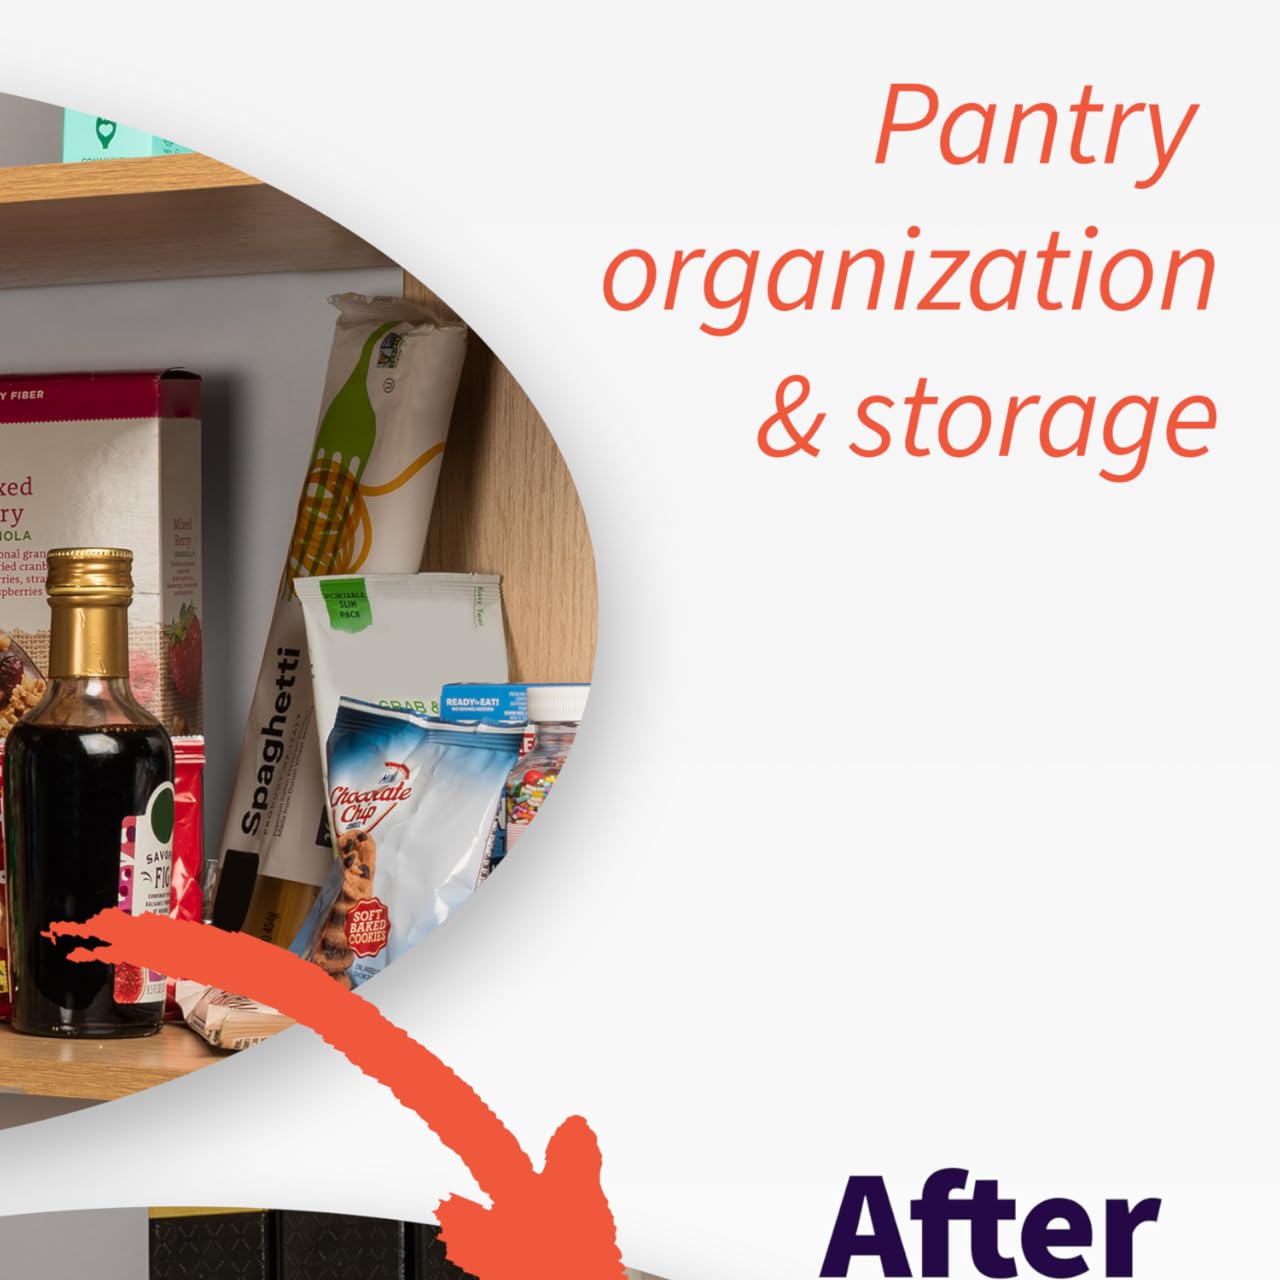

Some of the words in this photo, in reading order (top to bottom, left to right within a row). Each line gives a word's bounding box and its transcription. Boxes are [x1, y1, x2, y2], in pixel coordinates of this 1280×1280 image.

[10, 389, 45, 401] FIBER
[323, 592, 367, 600] PORTABLE
[338, 600, 358, 609] SLIM
[339, 610, 362, 619] PACK
[240, 646, 302, 837] Spaghetti
[340, 802, 378, 826] Chip
[353, 909, 382, 924] SOFT
[349, 919, 388, 934] BAKED
[348, 930, 388, 947] COOKIES
